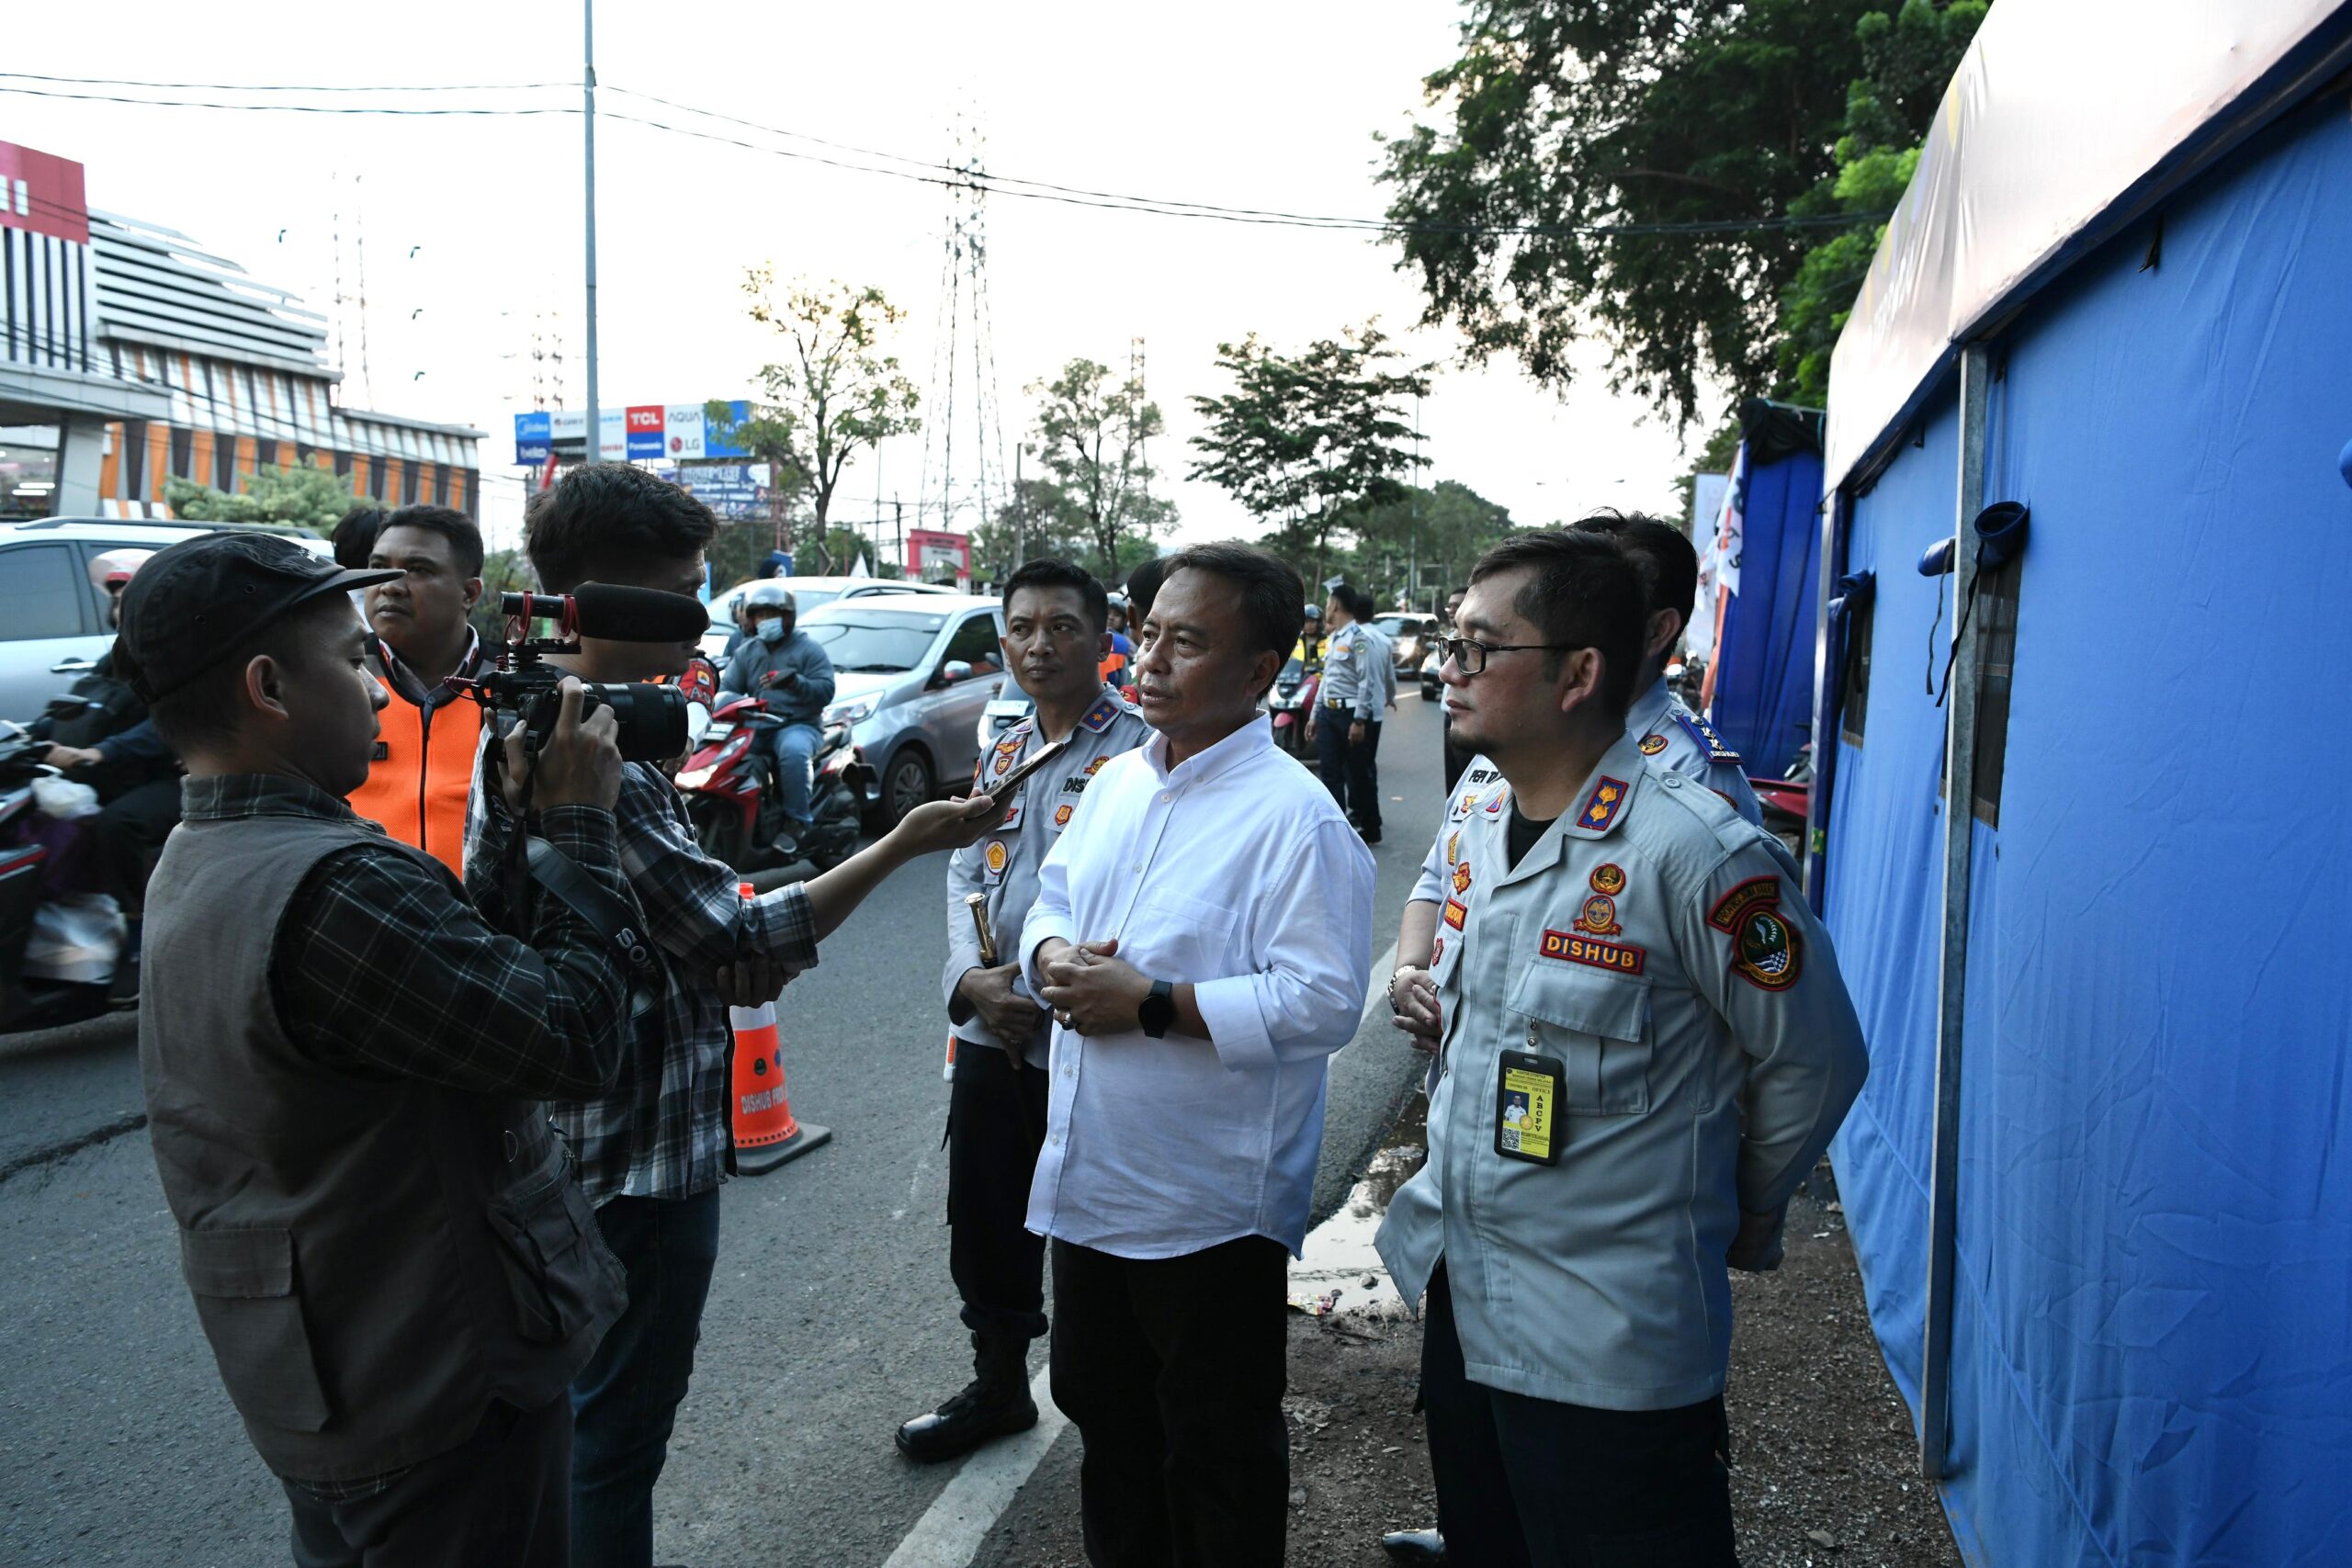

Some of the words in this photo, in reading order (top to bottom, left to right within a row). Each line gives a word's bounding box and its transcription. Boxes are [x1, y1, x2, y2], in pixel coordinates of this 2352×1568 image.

[630, 412, 661, 425] TCL
[667, 412, 701, 423] AQUA
[684, 438, 700, 450] LG
[615, 928, 659, 976] SON
[1546, 936, 1635, 968] DISHUB
[1532, 1087, 1552, 1095] OFFICE
[741, 1089, 772, 1115] DISHUB
